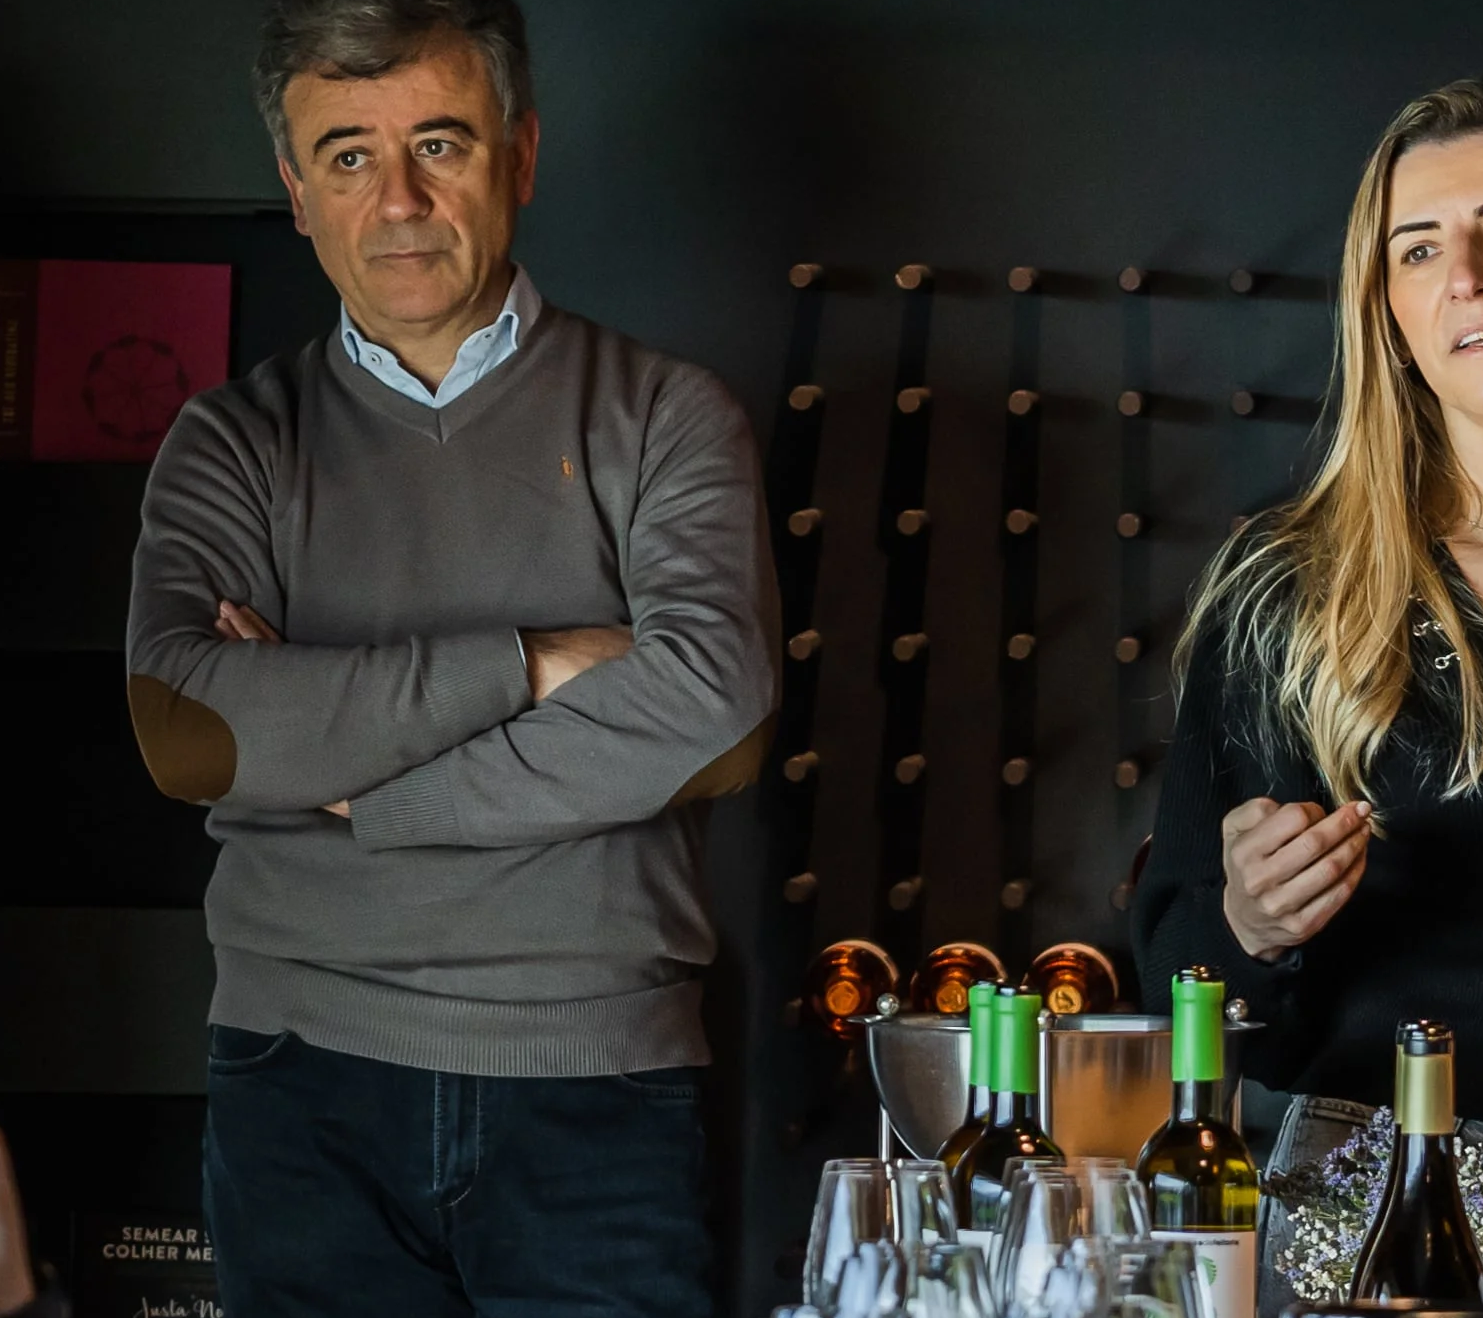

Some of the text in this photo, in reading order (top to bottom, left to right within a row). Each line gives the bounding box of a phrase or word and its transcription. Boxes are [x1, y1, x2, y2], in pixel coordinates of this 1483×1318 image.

[122, 1226, 198, 1243] SEMEAR
[102, 1243, 218, 1262] COLHER ME
